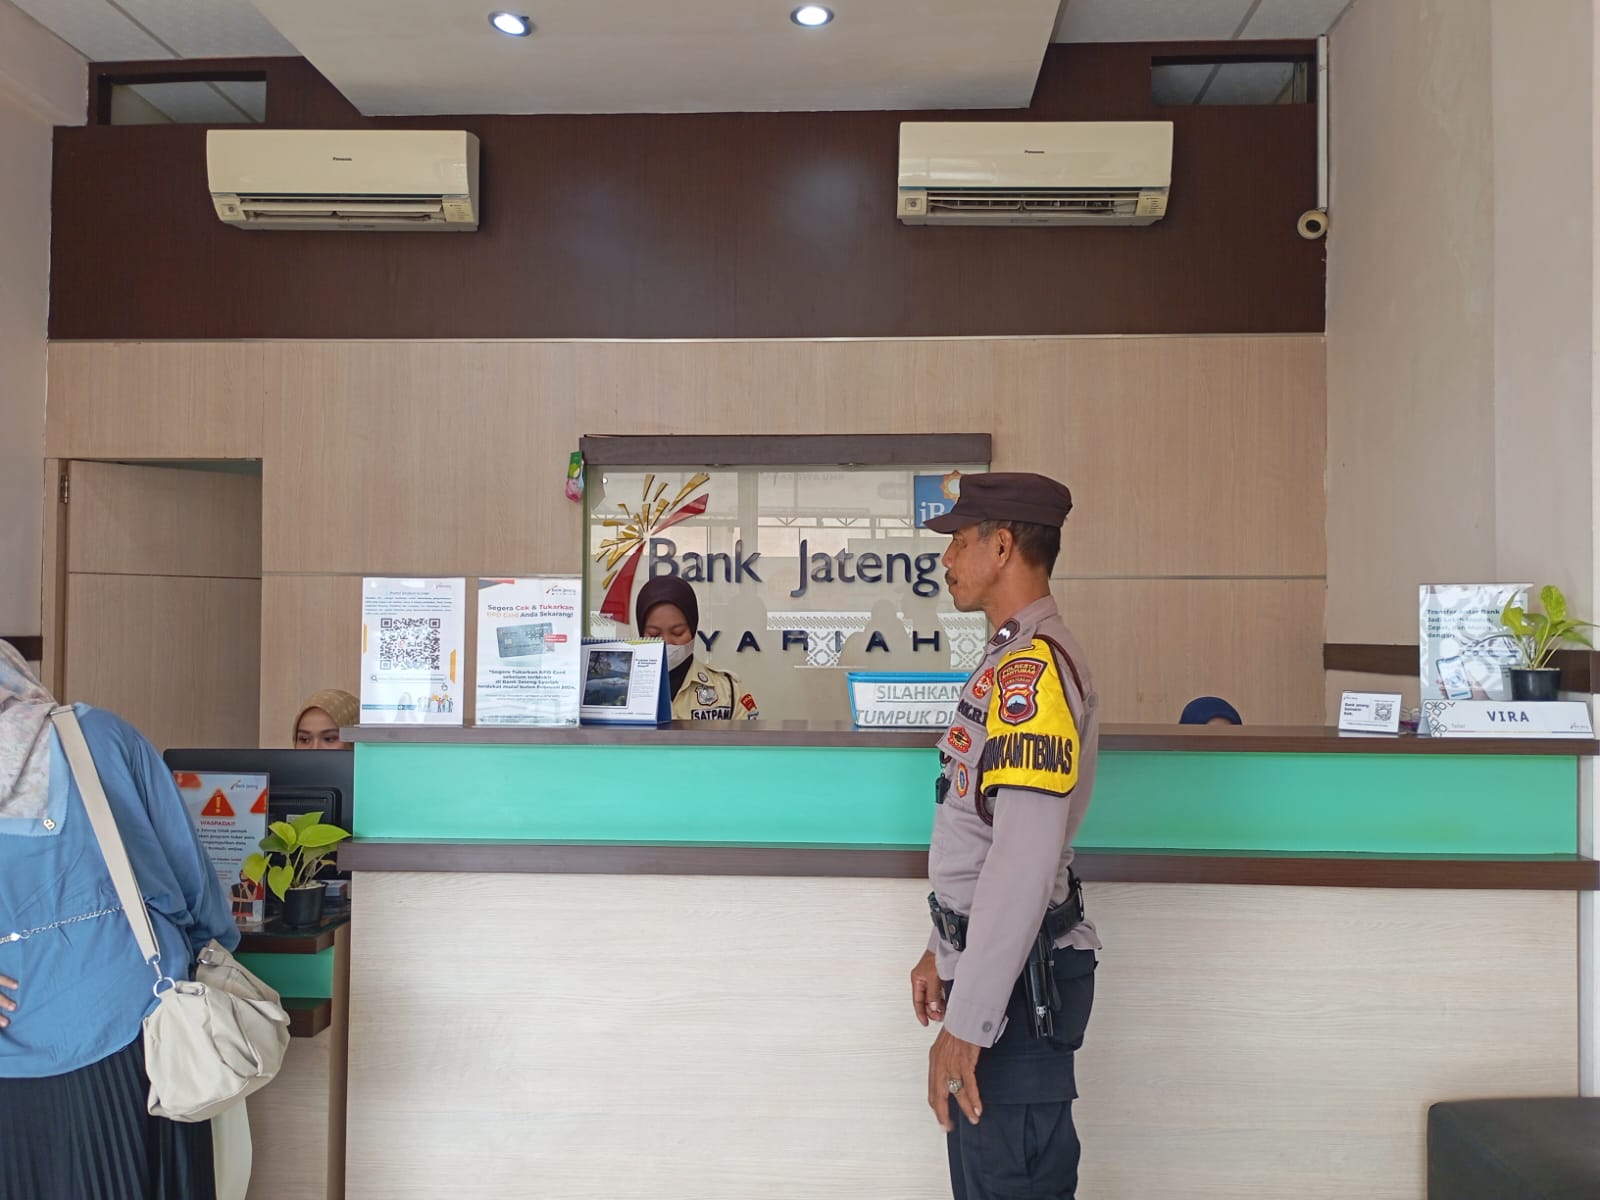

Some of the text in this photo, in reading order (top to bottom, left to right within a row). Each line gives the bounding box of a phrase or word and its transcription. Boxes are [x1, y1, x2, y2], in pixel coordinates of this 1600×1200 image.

[649, 537, 940, 597] Bank Jateng
[487, 604, 514, 612] Segera
[697, 630, 940, 652] YARIAH
[877, 685, 962, 700] SILAHKAN
[694, 709, 731, 720] SATPAM
[856, 709, 932, 725] TUMPUK
[1487, 711, 1530, 722] VIRA
